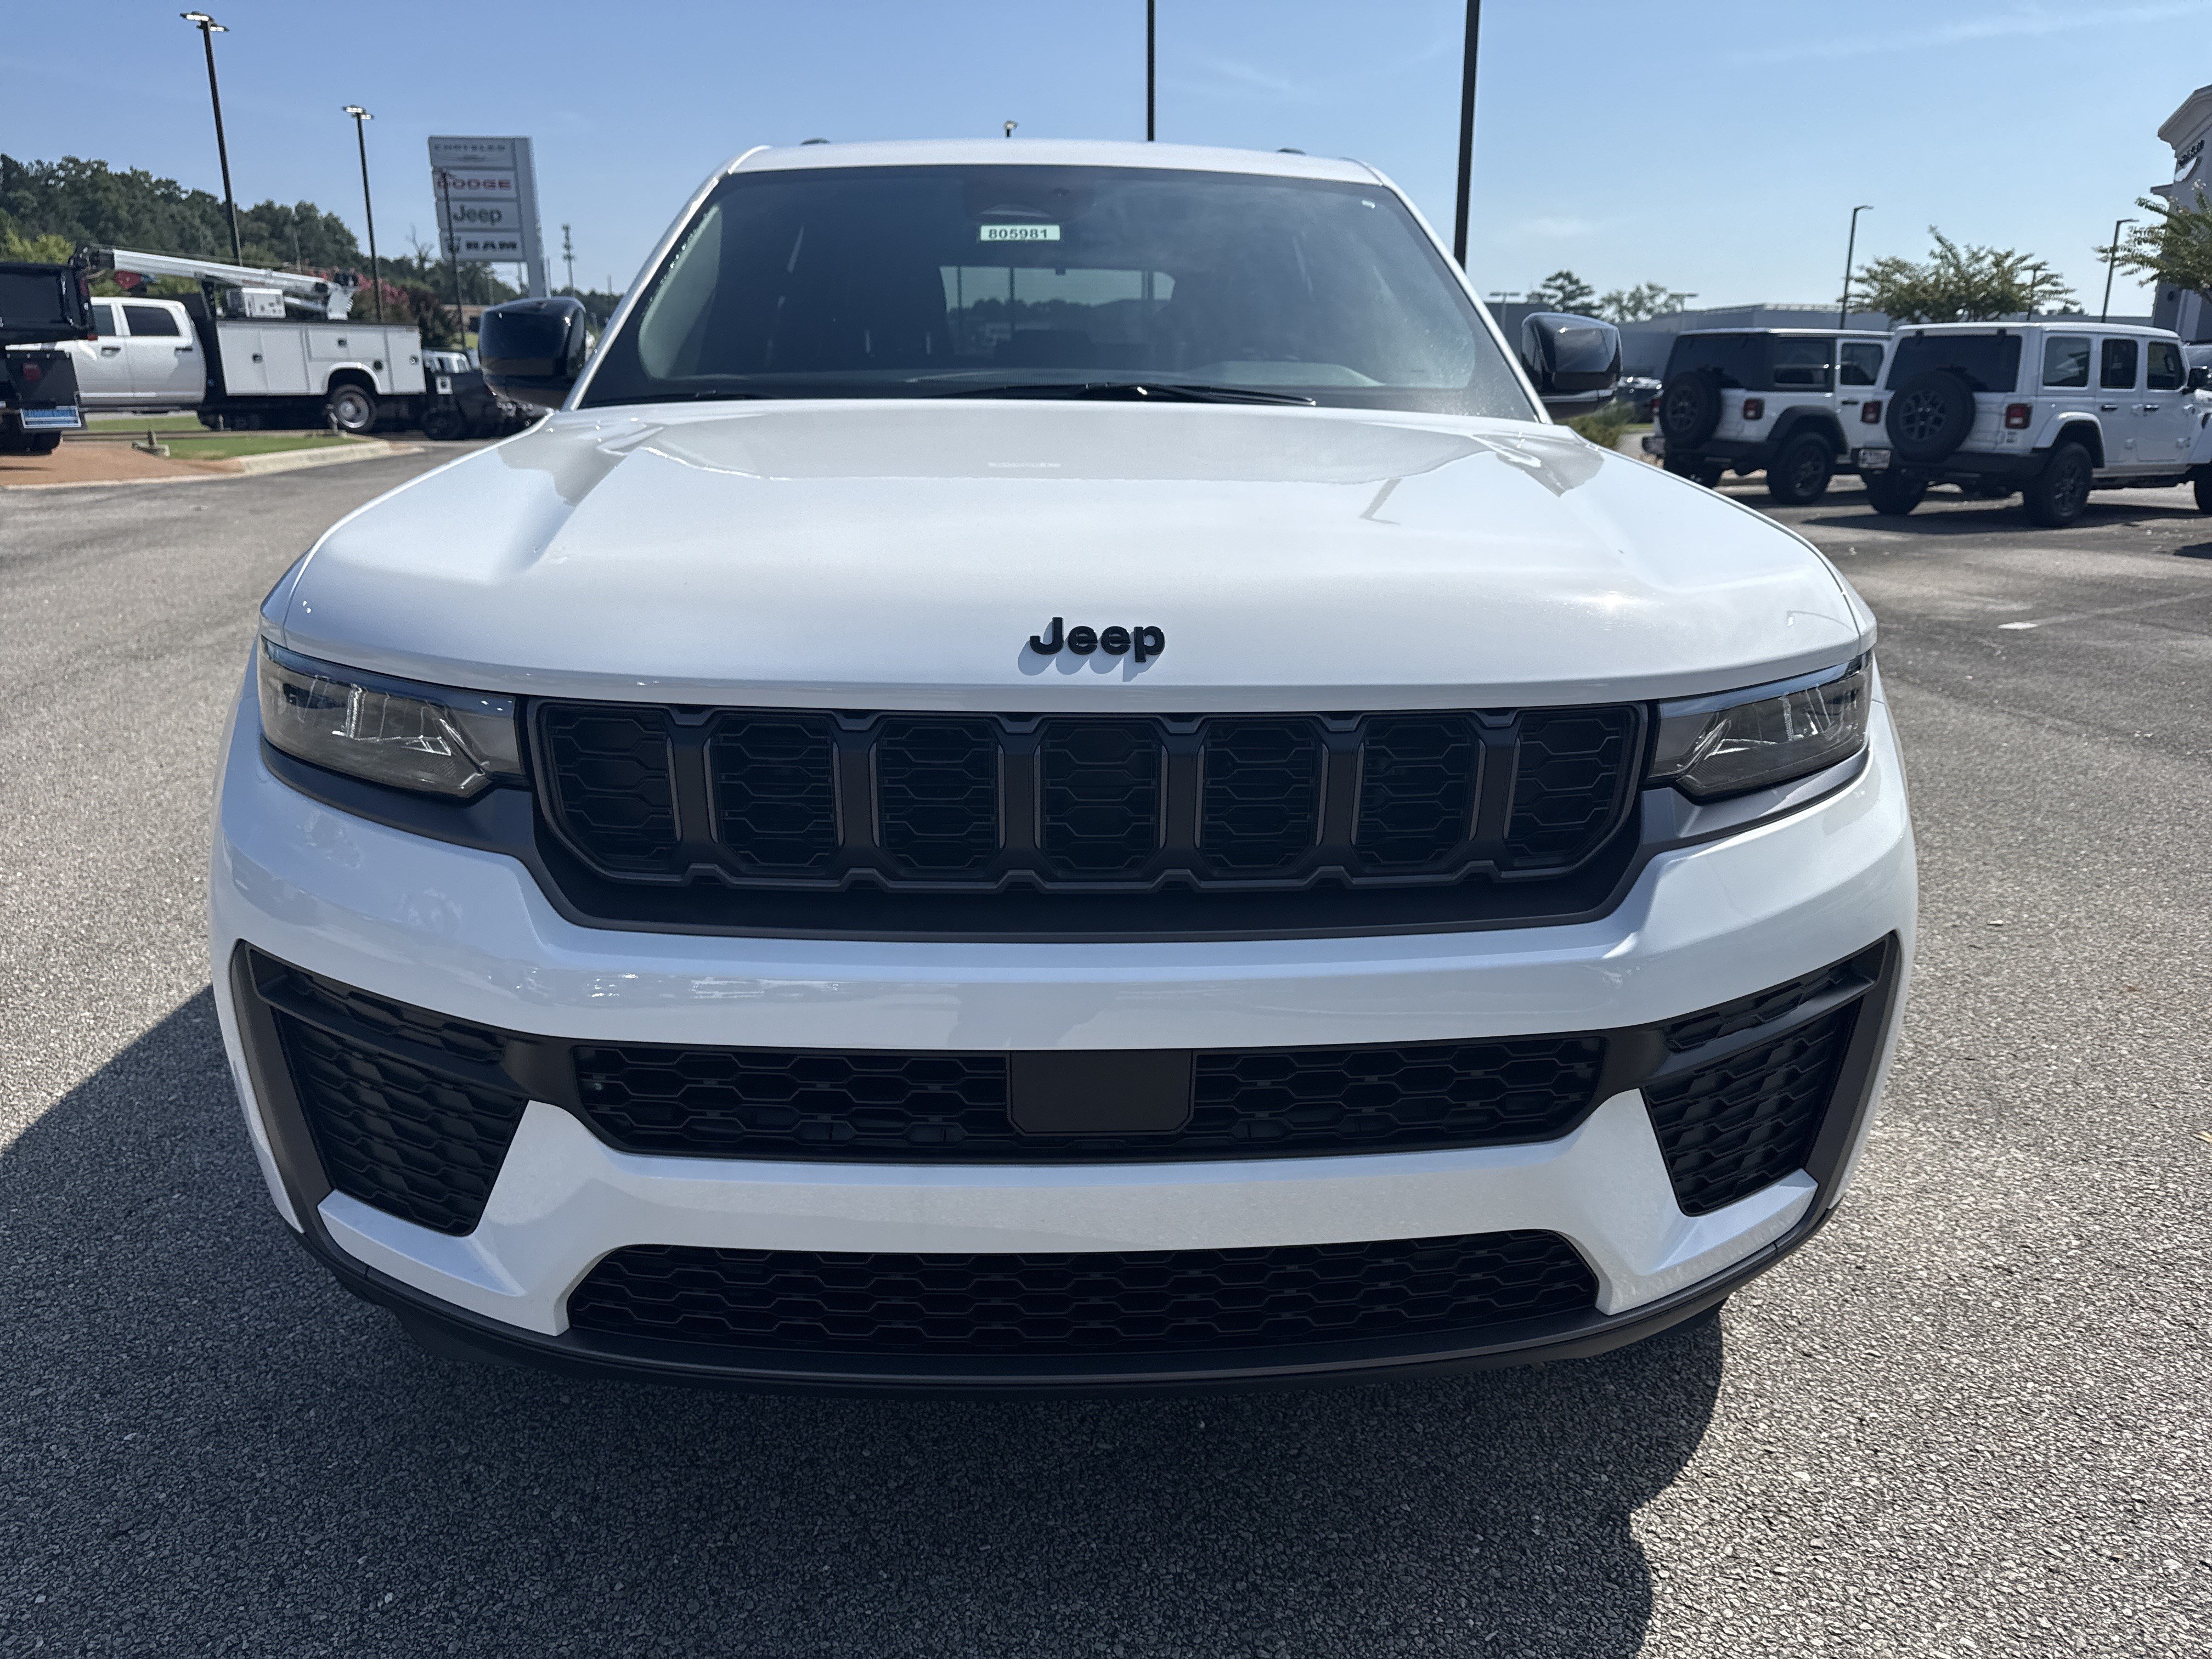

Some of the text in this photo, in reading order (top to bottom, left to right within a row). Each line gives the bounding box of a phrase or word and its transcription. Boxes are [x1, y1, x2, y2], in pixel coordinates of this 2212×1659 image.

[453, 205, 503, 225] Jeep
[989, 228, 1047, 239] 805981
[465, 240, 517, 250] RAM
[1030, 617, 1165, 662] Jeep
